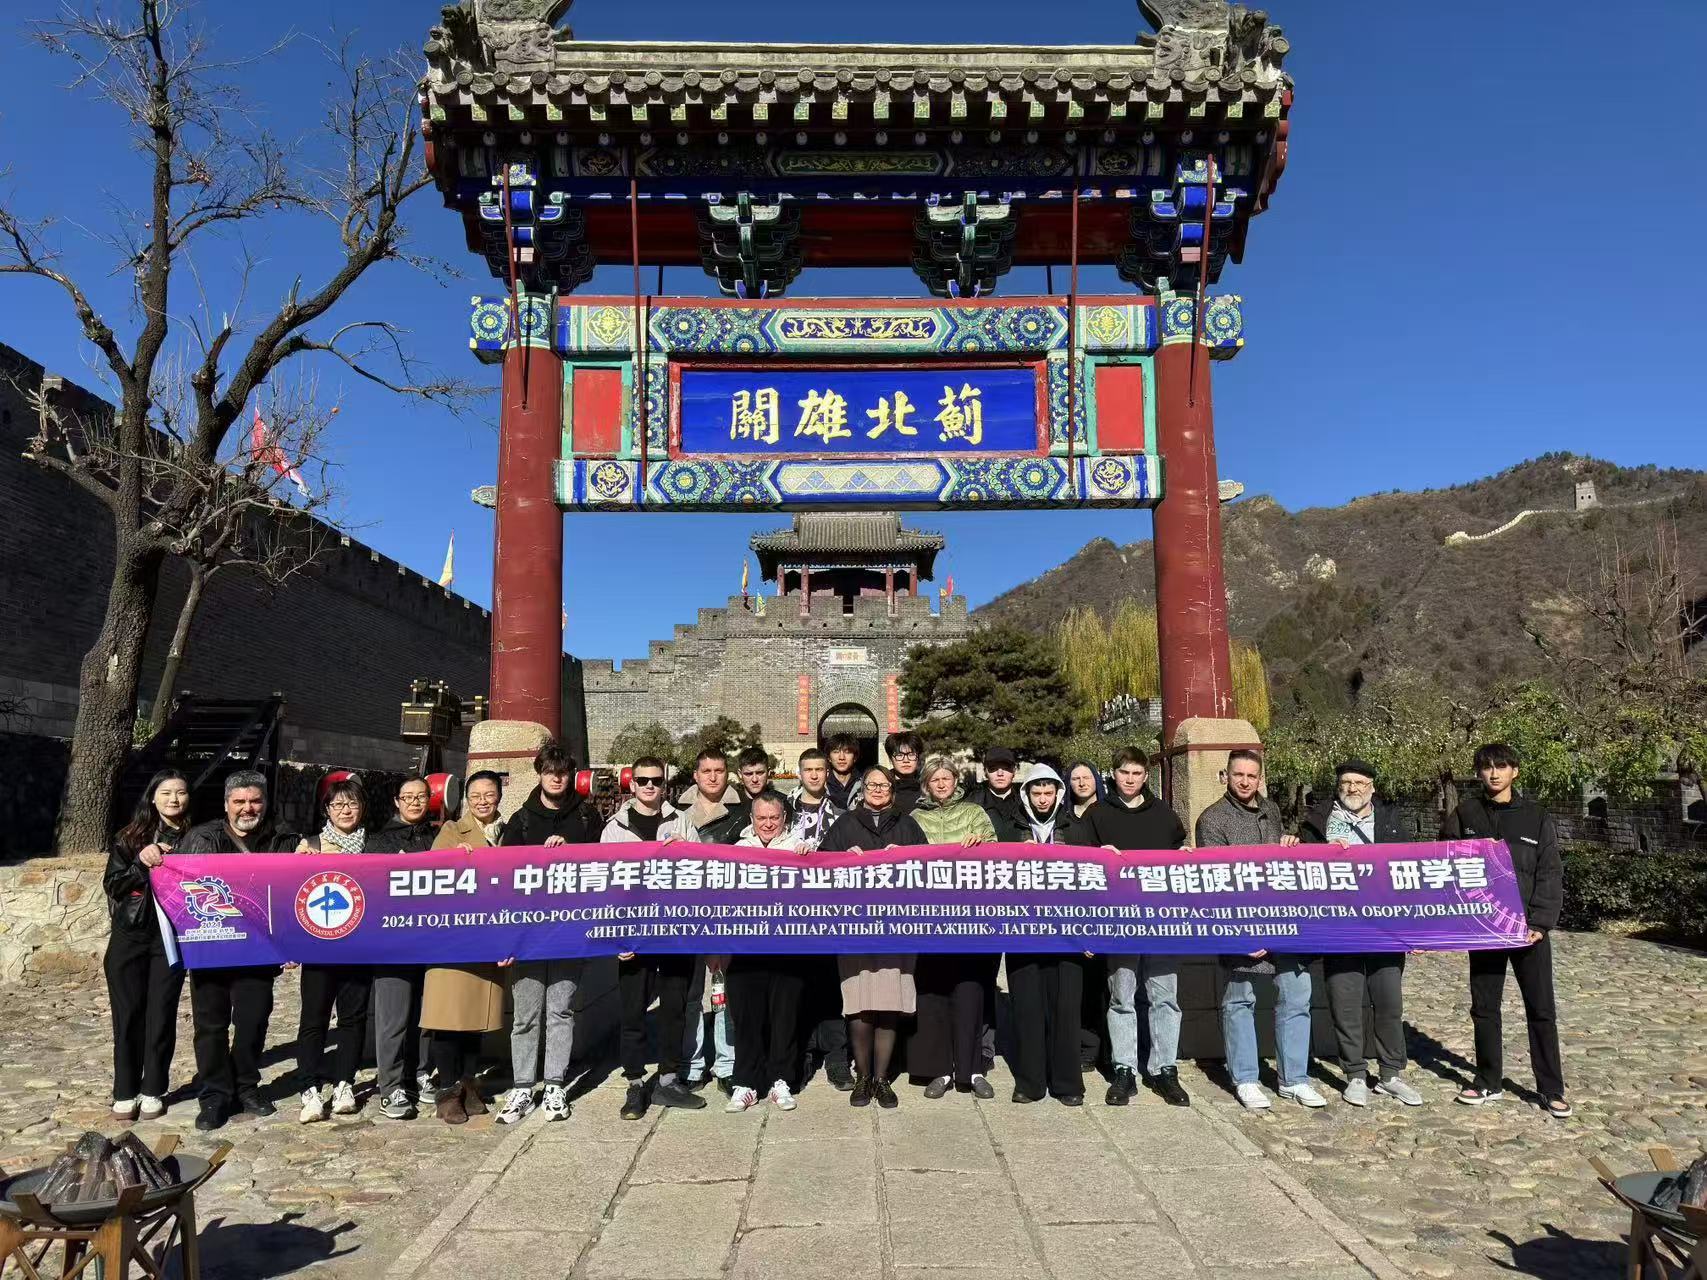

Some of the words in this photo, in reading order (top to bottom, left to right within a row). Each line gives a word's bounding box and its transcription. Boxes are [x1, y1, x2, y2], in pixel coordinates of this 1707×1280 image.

[381, 914, 413, 928] 2024
[417, 913, 450, 929] ГОД
[453, 903, 660, 929] КИТАЙСКО-РОССИЙСКИЙ
[663, 902, 784, 918] МОЛОДЕЖНЫЙ
[788, 904, 863, 917] КОНКУРС
[866, 904, 972, 917] ПРИМЕНЕНИЯ
[974, 905, 1031, 917] НОВЫХ
[1033, 904, 1142, 919] ТЕХНОЛОГИЙ
[1144, 906, 1156, 919] В
[1158, 906, 1233, 920] ОТРАСЛИ
[1236, 905, 1358, 920] ПРОИЗВОДСТВА
[1362, 901, 1492, 919] ОБОРУДОВАНИЯ
[585, 920, 770, 939] «ИНТЕЛЛЕКТУАЛЬНЫЙ
[773, 919, 885, 936] АППАРАТНЫЙ
[888, 922, 996, 936] МОНТАЖНИК»
[998, 922, 1058, 935] ЛАГЕРЬ
[1061, 921, 1193, 938] ИССЛЕДОВАНИЙ
[1196, 924, 1209, 937] И
[1211, 923, 1299, 937] ОБУЧЕНИЯ
